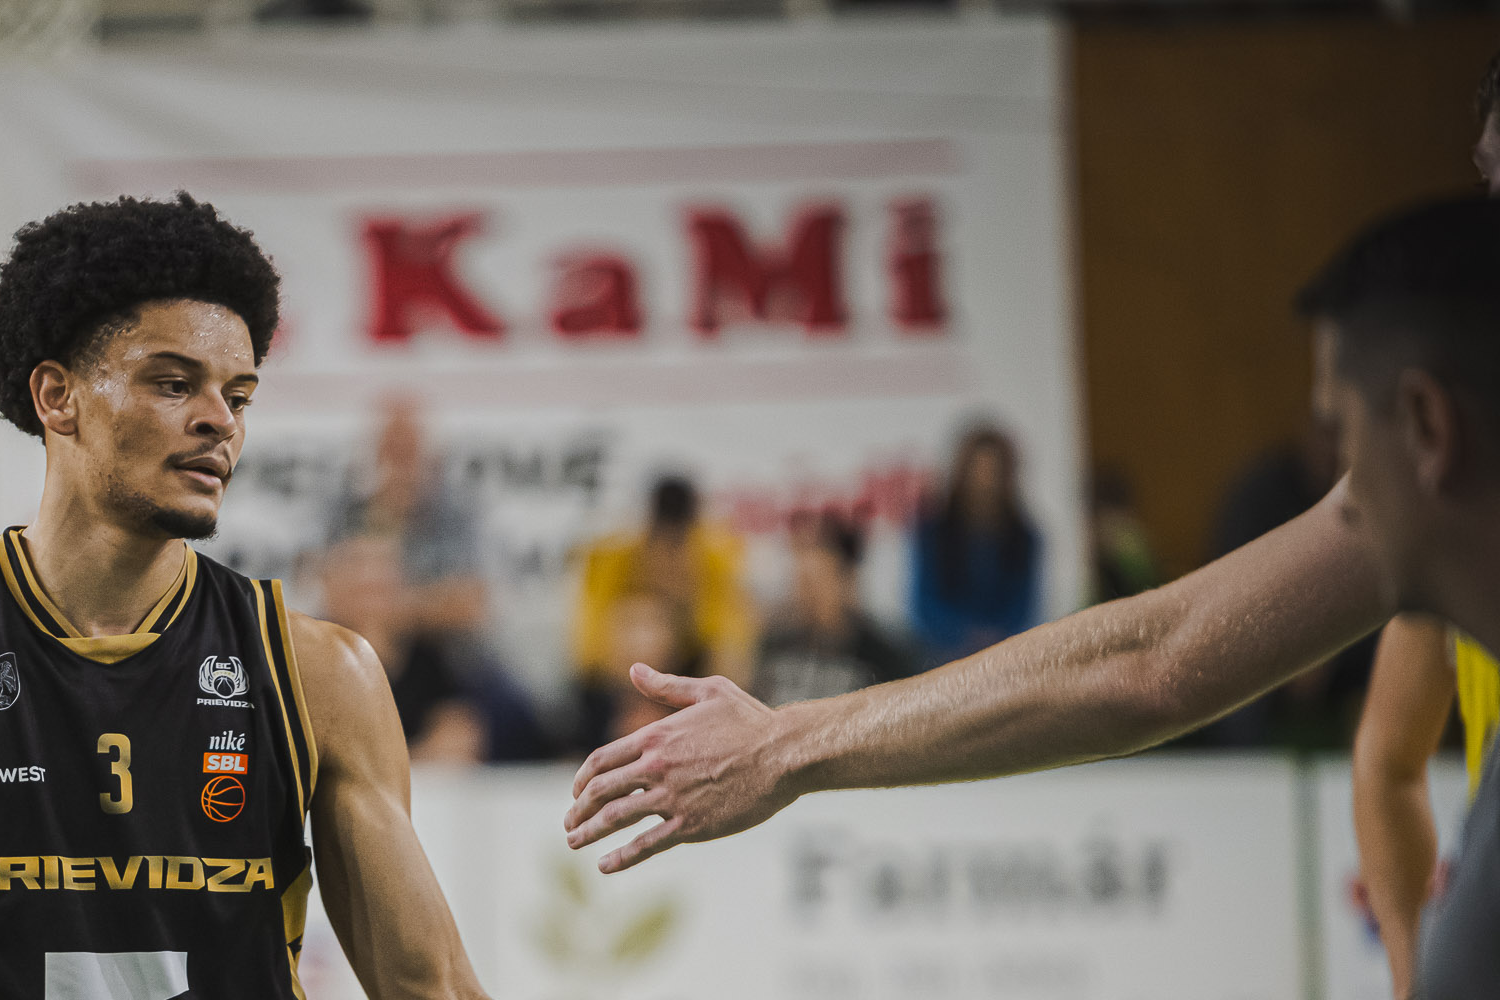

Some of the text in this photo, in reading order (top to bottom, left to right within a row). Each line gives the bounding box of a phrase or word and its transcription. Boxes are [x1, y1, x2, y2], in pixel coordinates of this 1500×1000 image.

[209, 730, 246, 751] niké
[207, 755, 245, 771] SBL
[97, 733, 134, 815] 3
